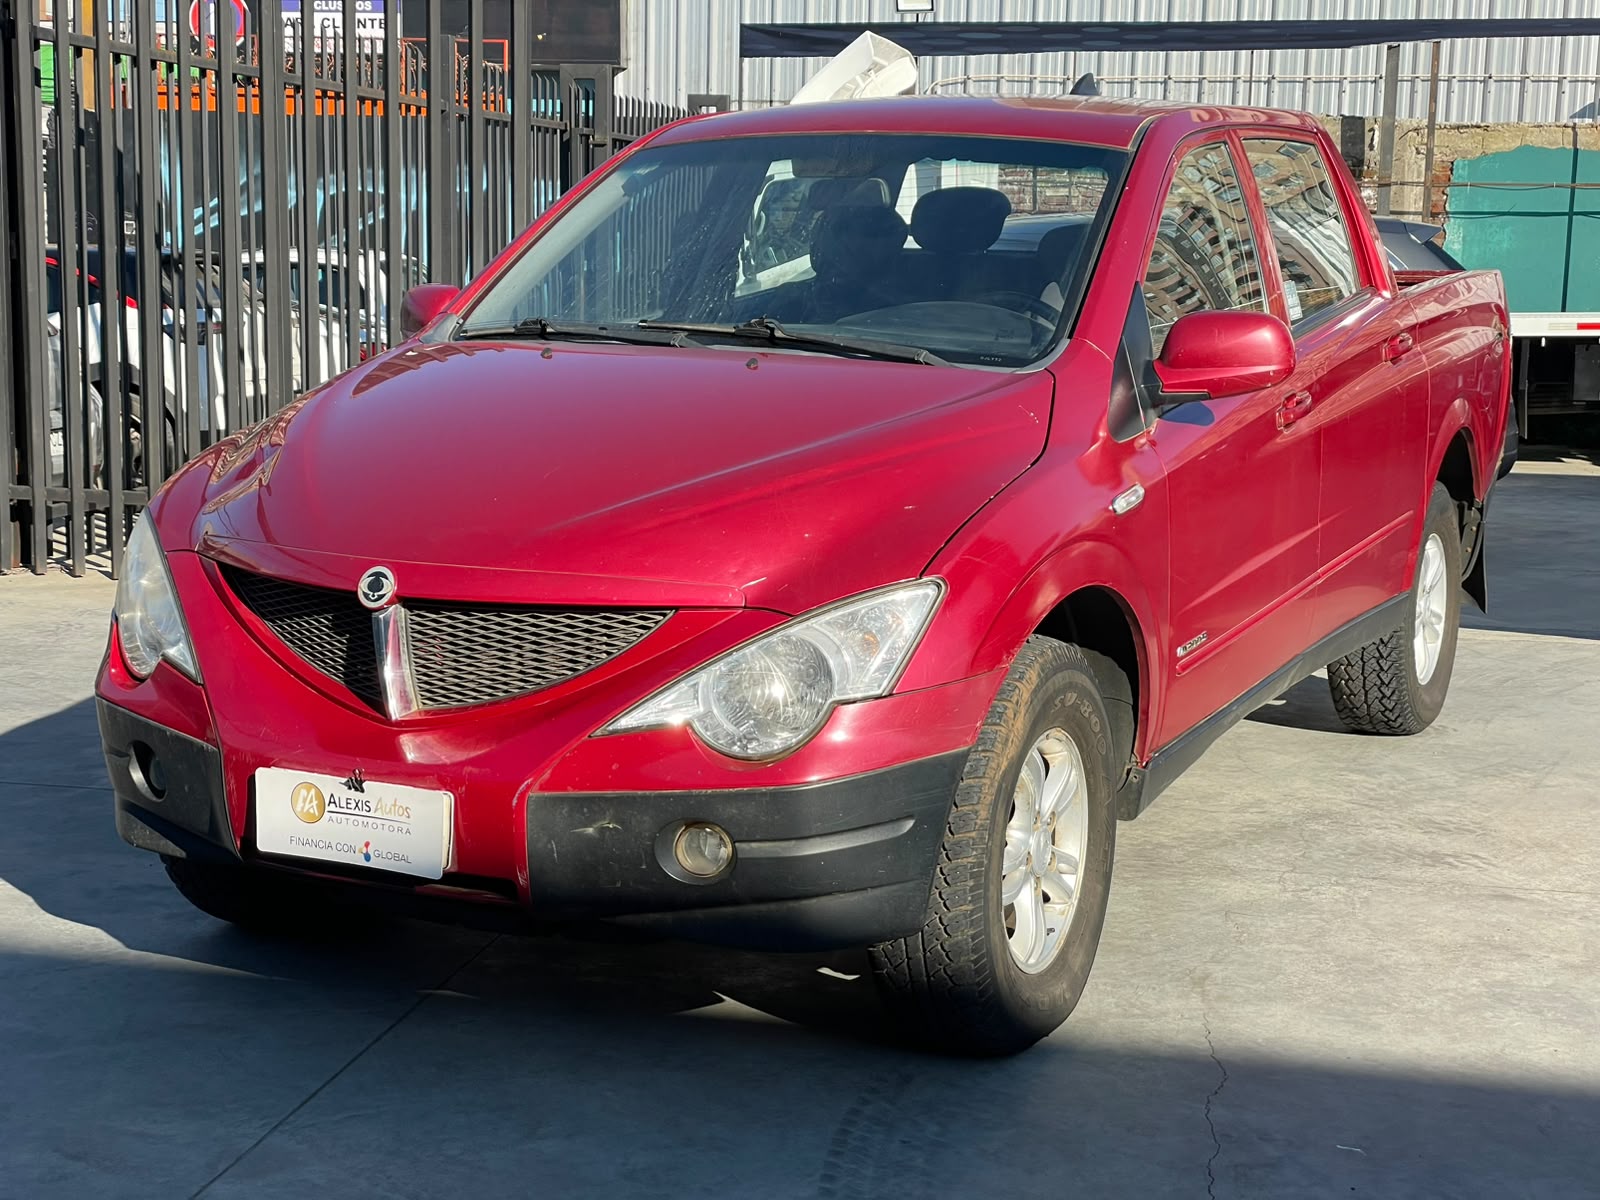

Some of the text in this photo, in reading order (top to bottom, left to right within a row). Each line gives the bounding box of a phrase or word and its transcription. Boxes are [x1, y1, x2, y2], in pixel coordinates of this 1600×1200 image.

[327, 793, 411, 819] ALEXIS Autos
[327, 816, 412, 836] AUTOMOTORA
[289, 835, 412, 864] FINANCIA CON GLOBAL
